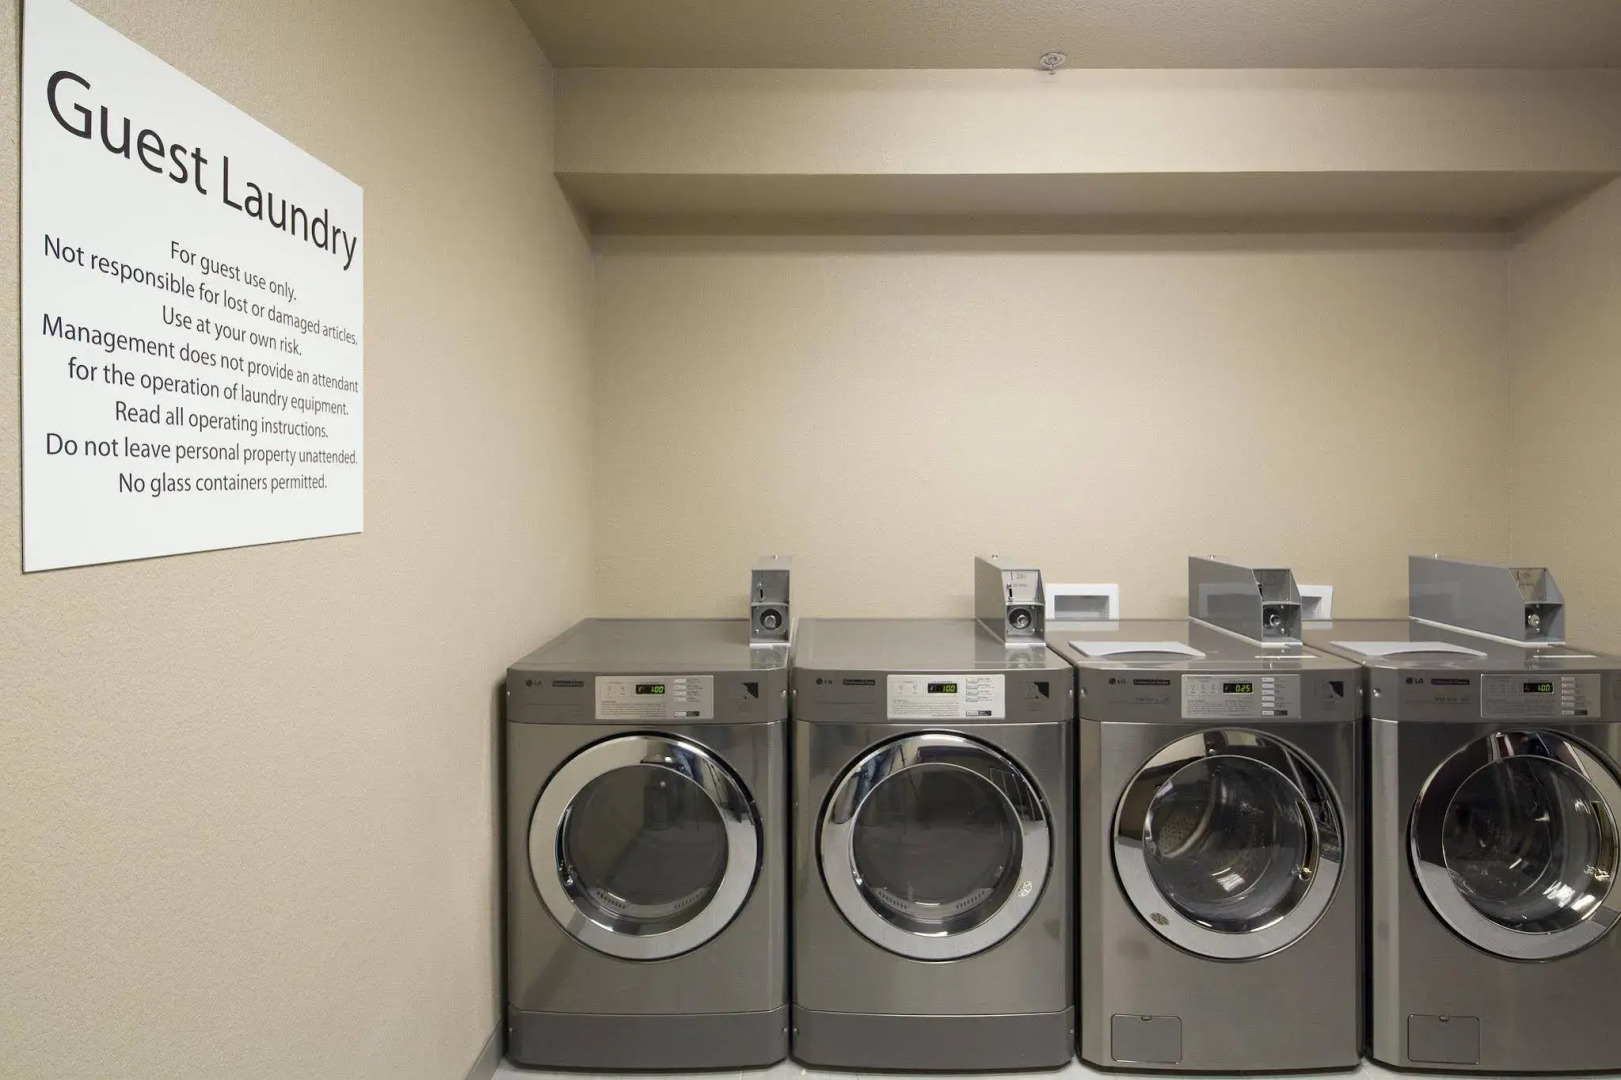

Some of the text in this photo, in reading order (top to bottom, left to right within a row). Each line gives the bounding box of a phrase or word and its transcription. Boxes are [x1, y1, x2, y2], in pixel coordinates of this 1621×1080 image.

[46, 70, 357, 271] Guest Laundry
[45, 234, 358, 345] Not responsible for lost or damaged articles.
[171, 240, 296, 303] For guest use only.
[43, 313, 358, 393] Management does not provide an attendant
[163, 305, 302, 356] Use at your own risk.
[68, 356, 348, 415] for the operation of laundry equipment.
[116, 401, 328, 438] Read all operating instructions.
[46, 433, 358, 466] Do not leave personal property unattended.
[119, 472, 327, 498] No glass containers permitted.
